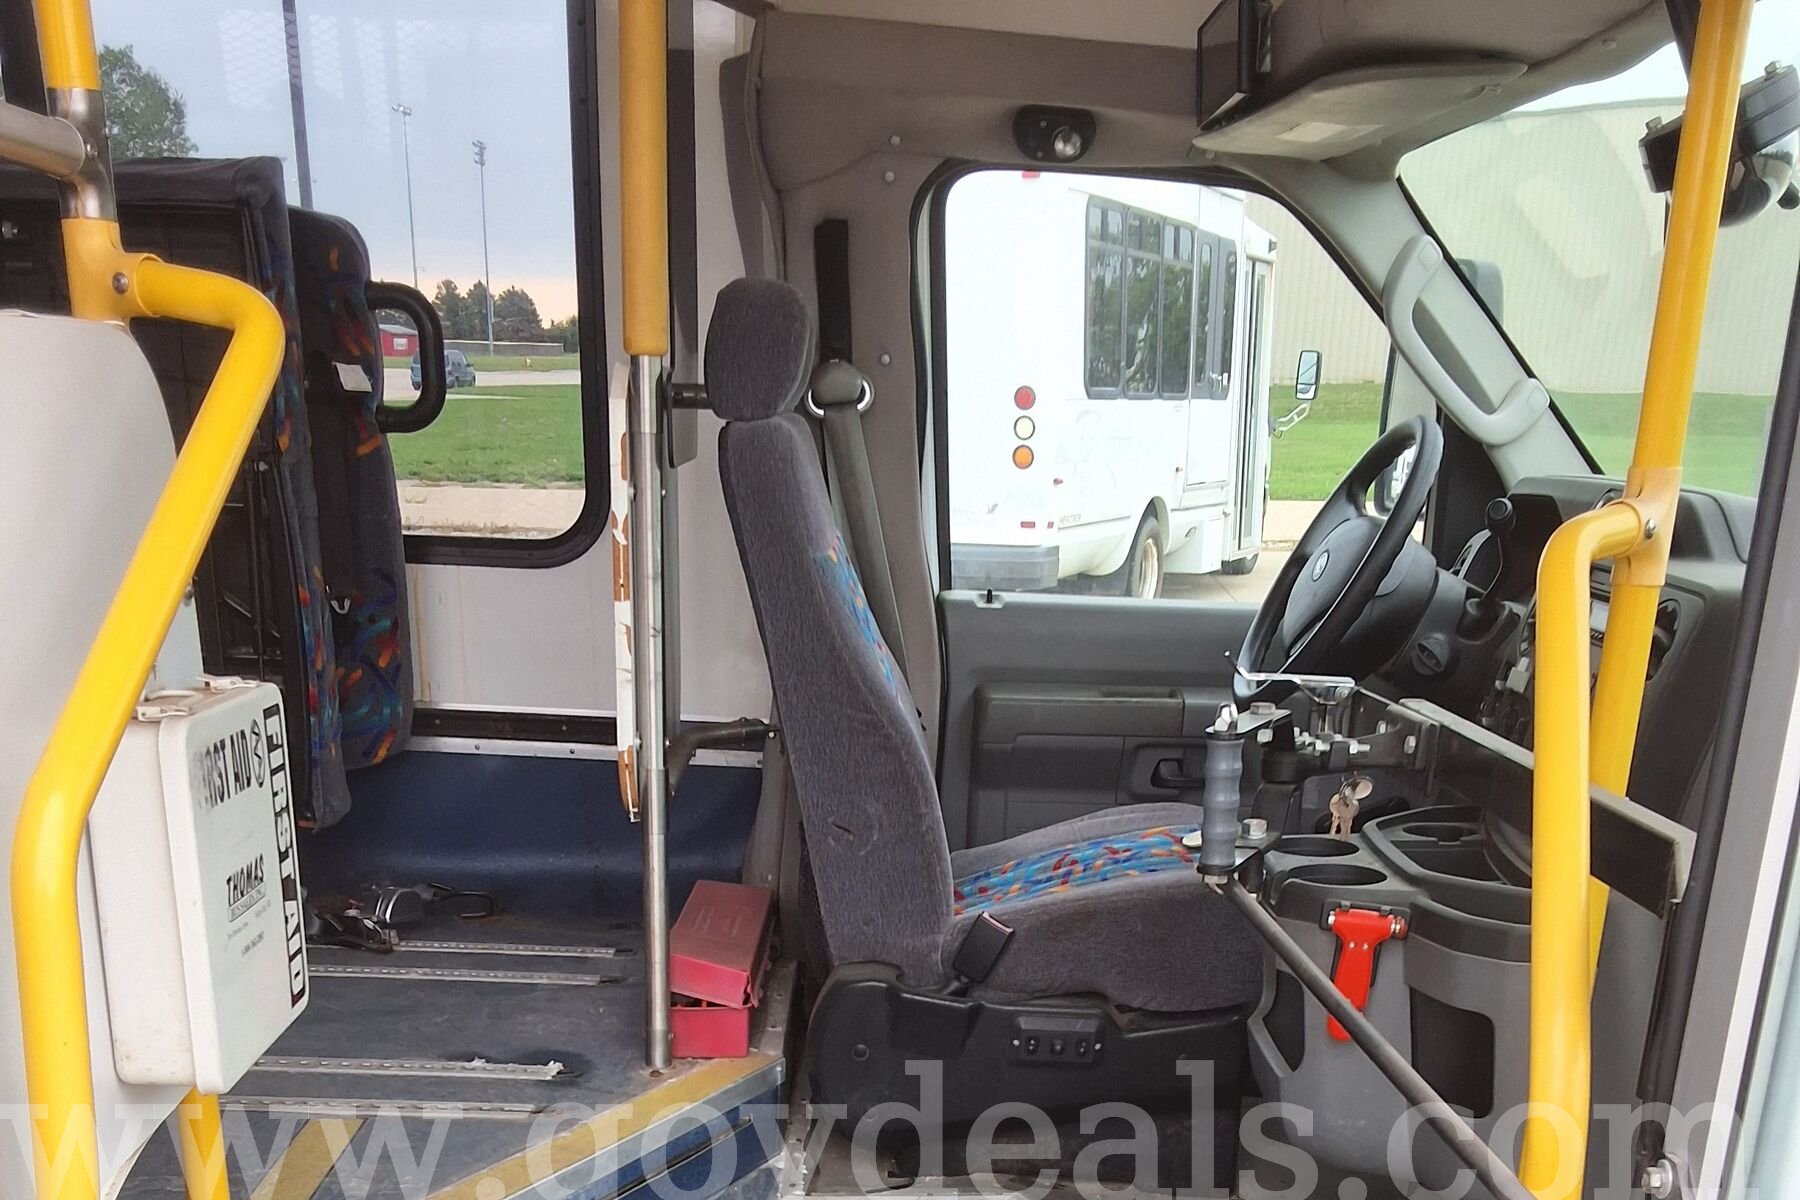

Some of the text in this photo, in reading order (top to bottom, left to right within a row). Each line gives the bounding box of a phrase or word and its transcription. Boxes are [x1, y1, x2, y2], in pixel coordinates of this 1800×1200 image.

[194, 729, 252, 810] IRST AID
[226, 853, 264, 907] THOMAS
[265, 714, 305, 997] FIRST AID
